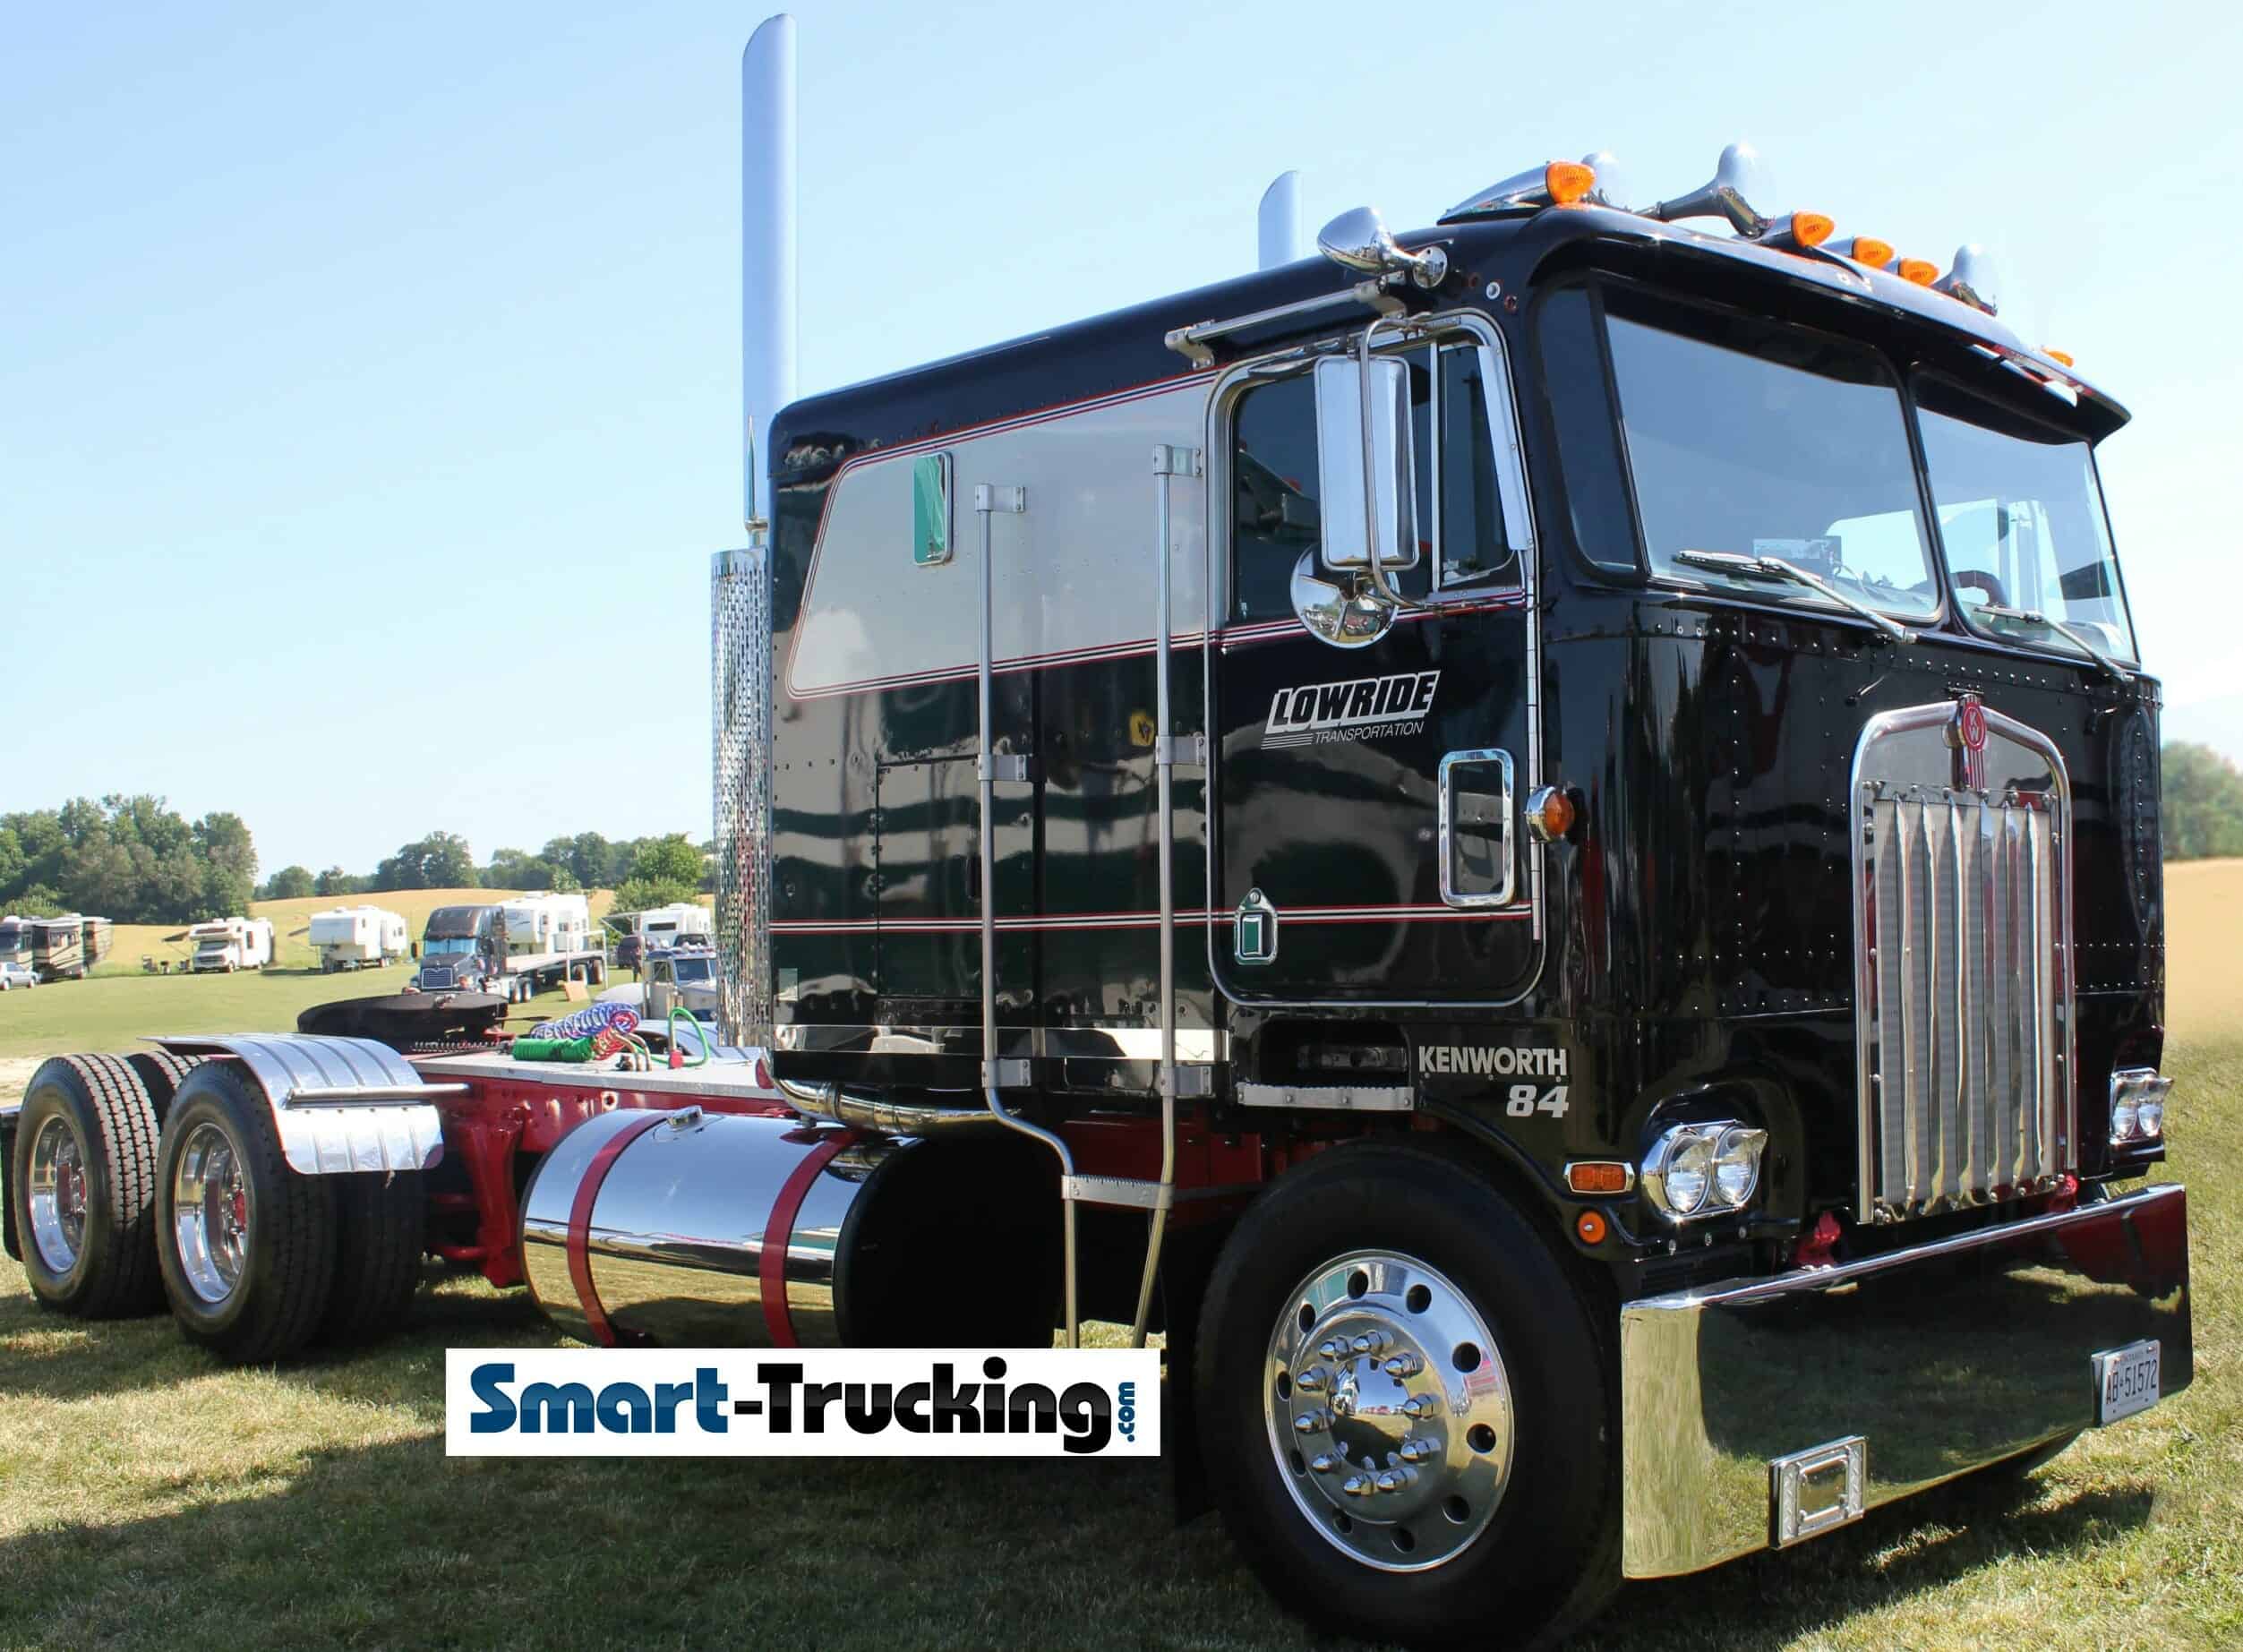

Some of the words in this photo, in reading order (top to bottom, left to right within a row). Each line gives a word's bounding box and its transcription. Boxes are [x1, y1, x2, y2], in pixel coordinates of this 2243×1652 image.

[1265, 671, 1440, 734] LOWRIDE
[1315, 722, 1424, 745] TRANSPORTATION
[1418, 1045, 1567, 1075] KENWORTH
[1506, 1084, 1569, 1117] 84
